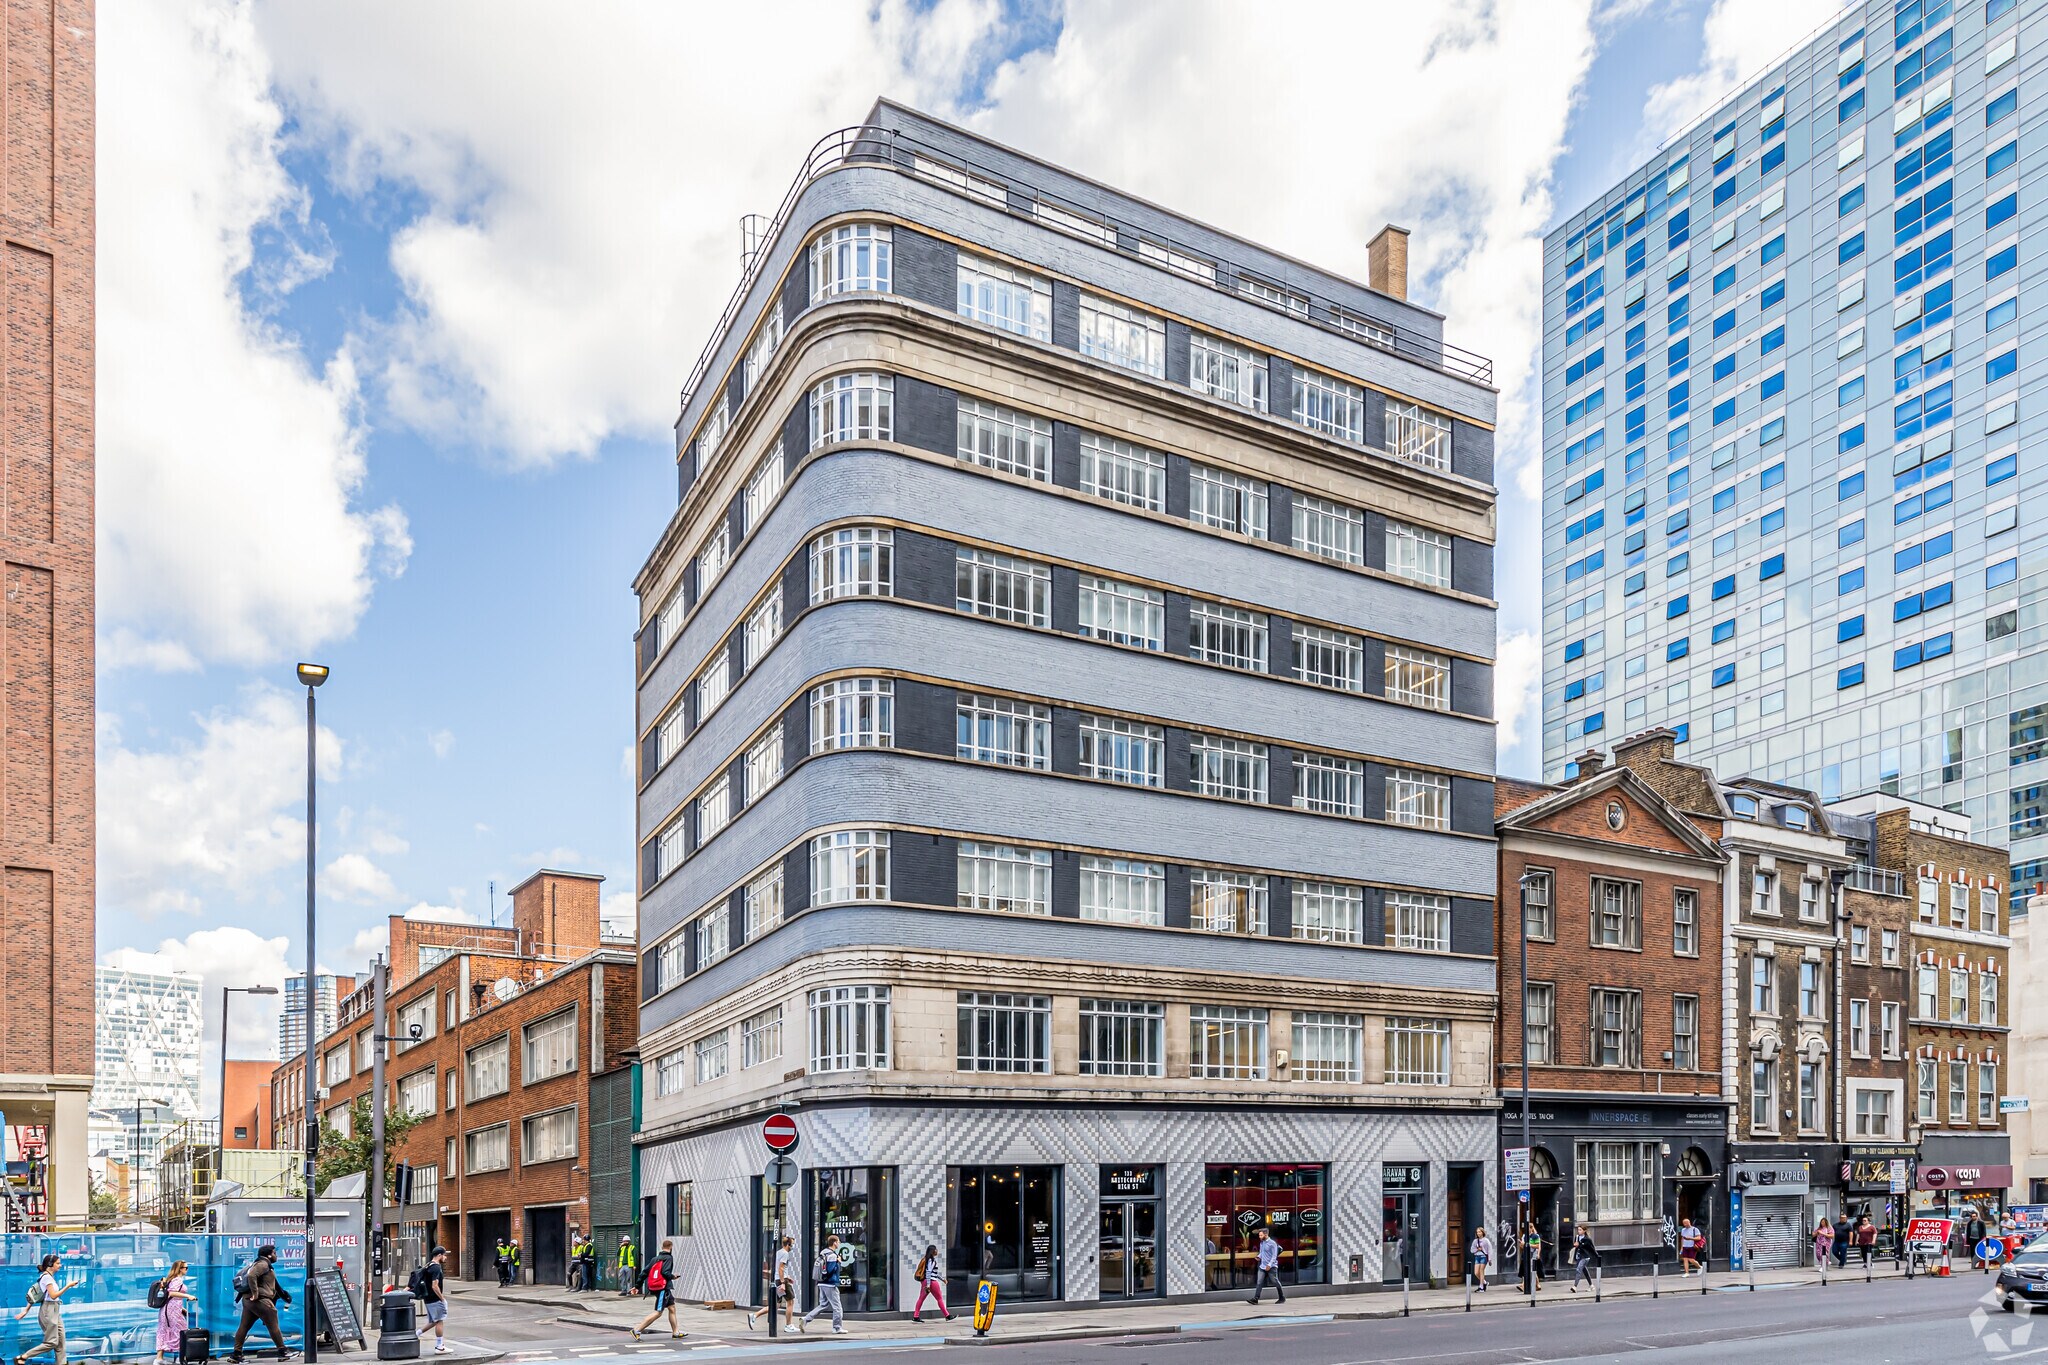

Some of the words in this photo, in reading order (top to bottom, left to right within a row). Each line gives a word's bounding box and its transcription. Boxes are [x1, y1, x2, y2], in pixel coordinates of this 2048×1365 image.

[1591, 1112, 1638, 1122] INNERSPACE
[1383, 1168, 1406, 1177] ARAVAN
[1780, 1171, 1807, 1181] EXPRESS
[1958, 1168, 1981, 1179] COSTA
[281, 1217, 306, 1225] HALA
[1272, 1211, 1290, 1221] CRAFT
[229, 1237, 250, 1248] HOT
